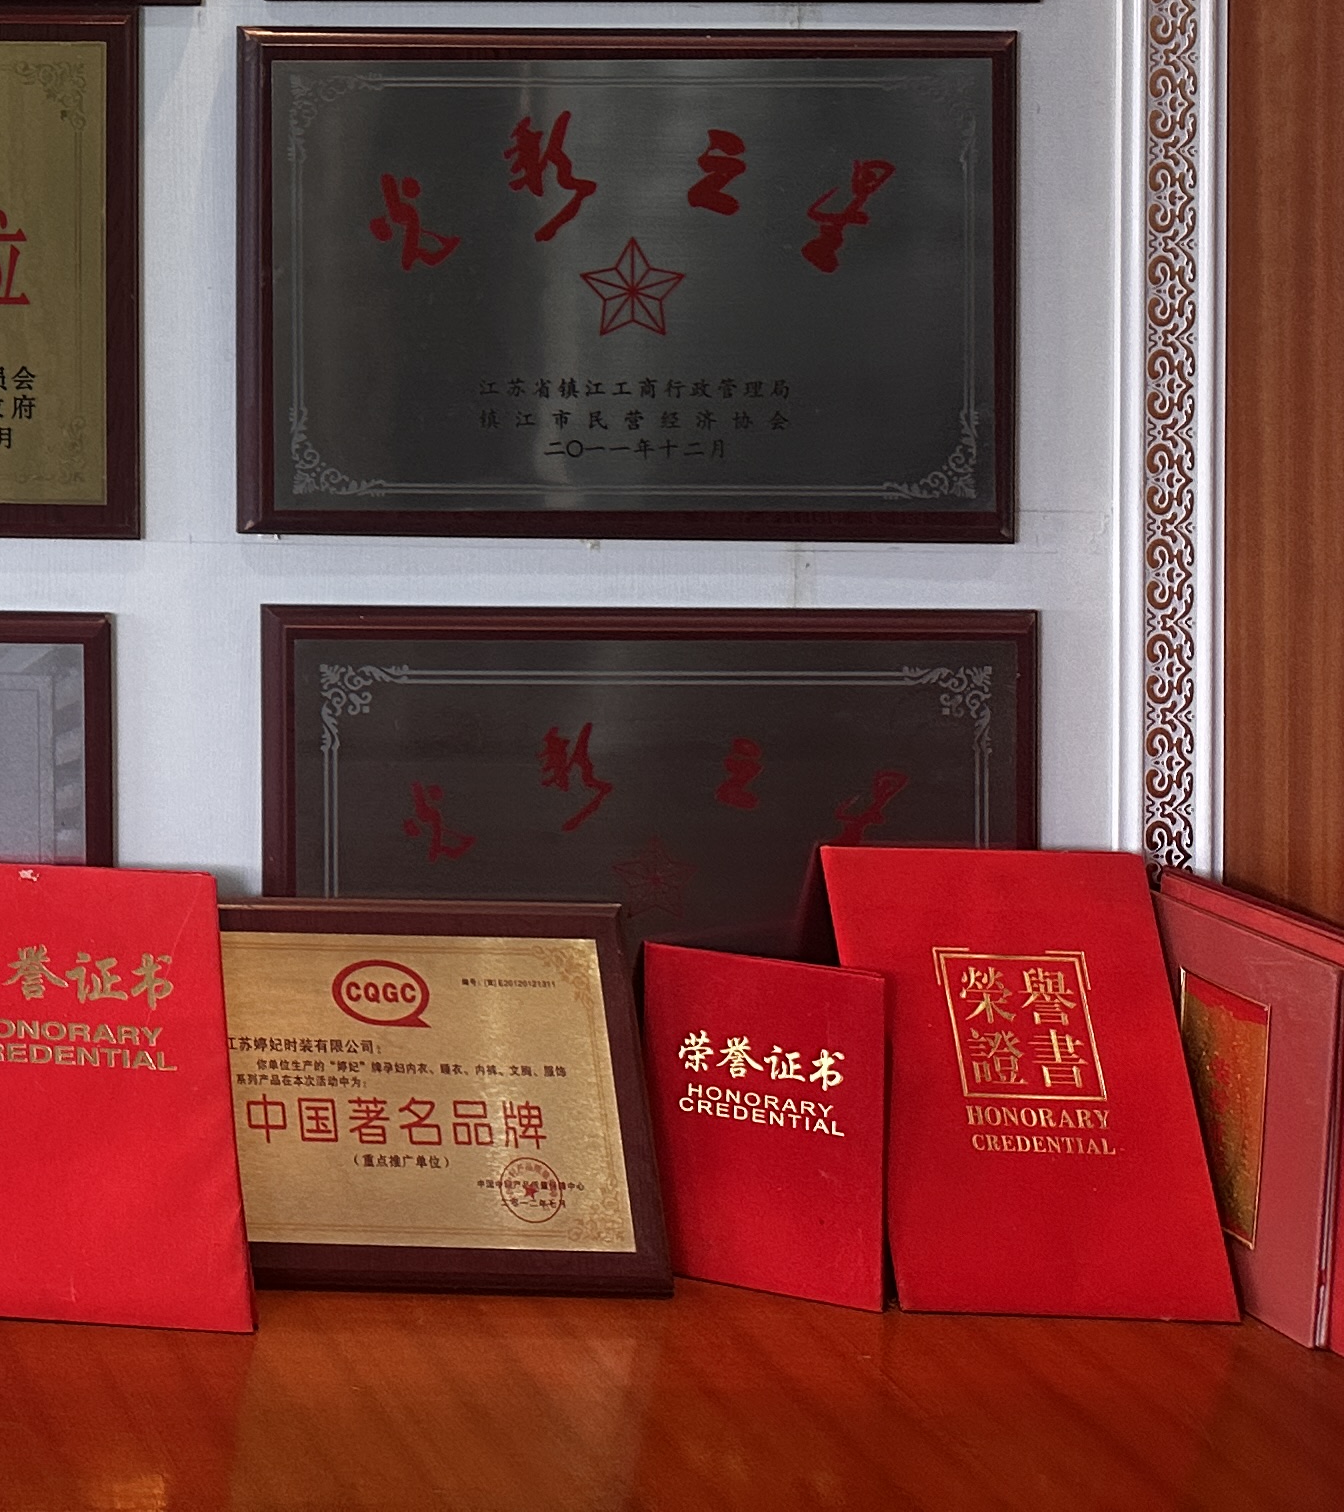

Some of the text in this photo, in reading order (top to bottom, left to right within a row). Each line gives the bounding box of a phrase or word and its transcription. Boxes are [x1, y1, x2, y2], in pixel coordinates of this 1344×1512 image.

[478, 377, 791, 400] 江苏省镇江工商行政管理局
[478, 408, 790, 431] 镇江市民营经济协会
[345, 982, 418, 1003] CQGC
[960, 966, 1076, 1026] 榮譽
[678, 1030, 845, 1091] 荣誉证书
[967, 1028, 1088, 1087] 證書
[678, 1097, 845, 1137] CREDENTIAL
[687, 1083, 834, 1118] HONORARY
[965, 1105, 1109, 1129] HONORARY
[245, 1094, 550, 1152] 中国著名品牌
[972, 1134, 1116, 1155] CREDENTIAL
